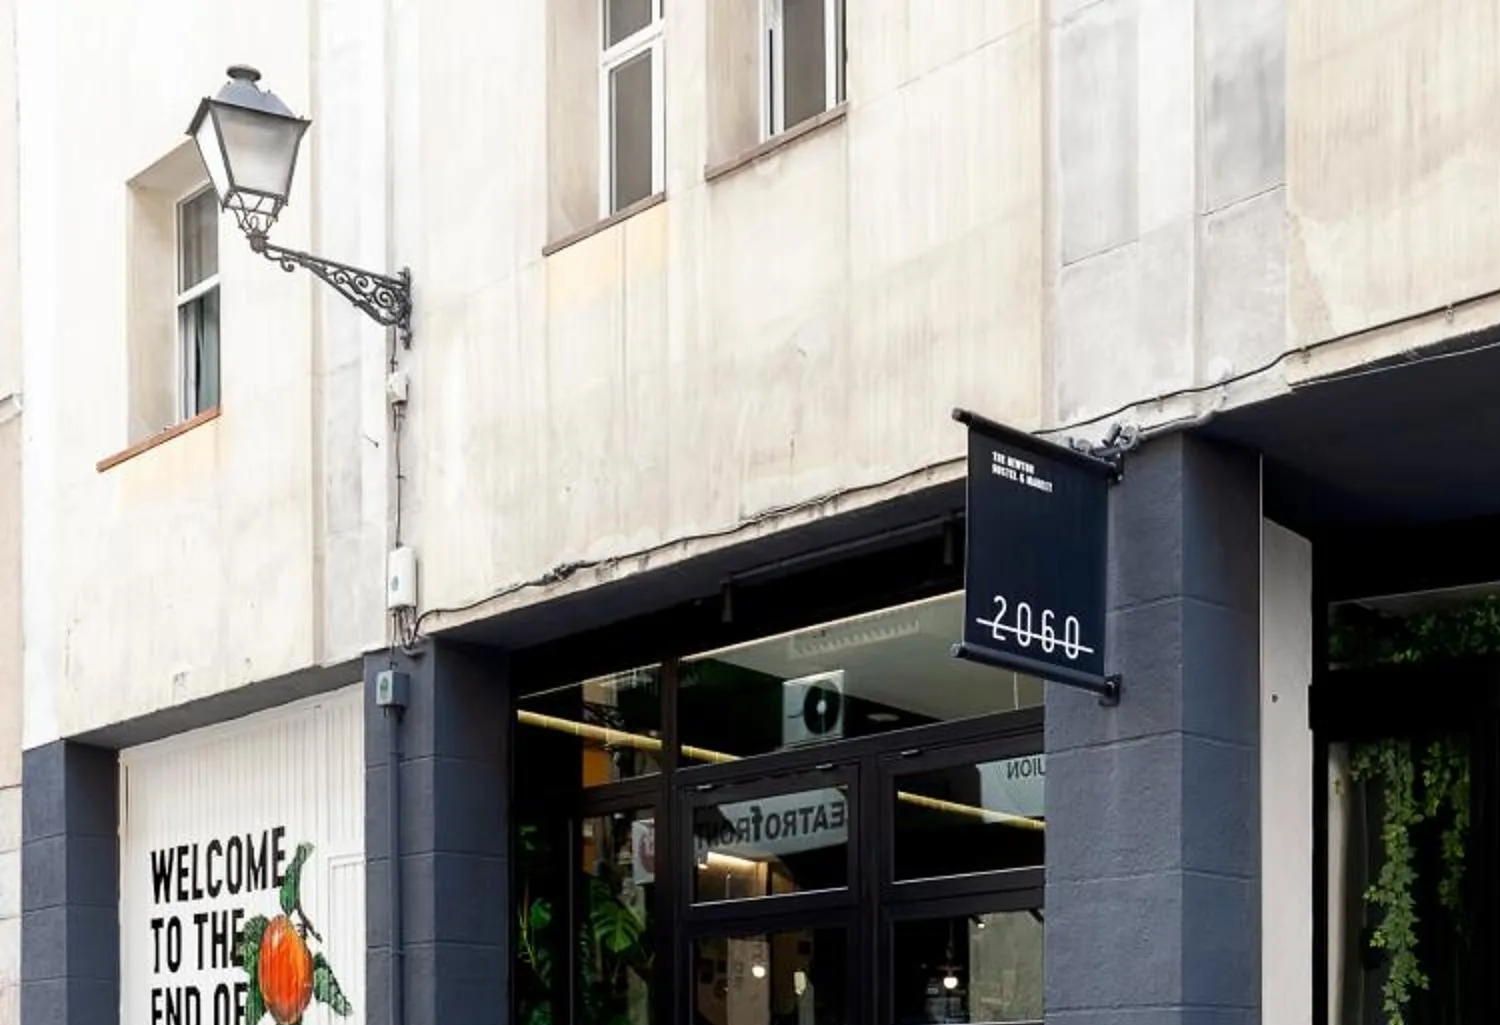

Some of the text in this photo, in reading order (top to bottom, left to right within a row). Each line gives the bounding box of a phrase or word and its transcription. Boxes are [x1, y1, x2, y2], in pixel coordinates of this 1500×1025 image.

[992, 595, 1080, 659] 2060
[150, 826, 286, 904] WELCOME
[150, 908, 245, 973] TO THE
